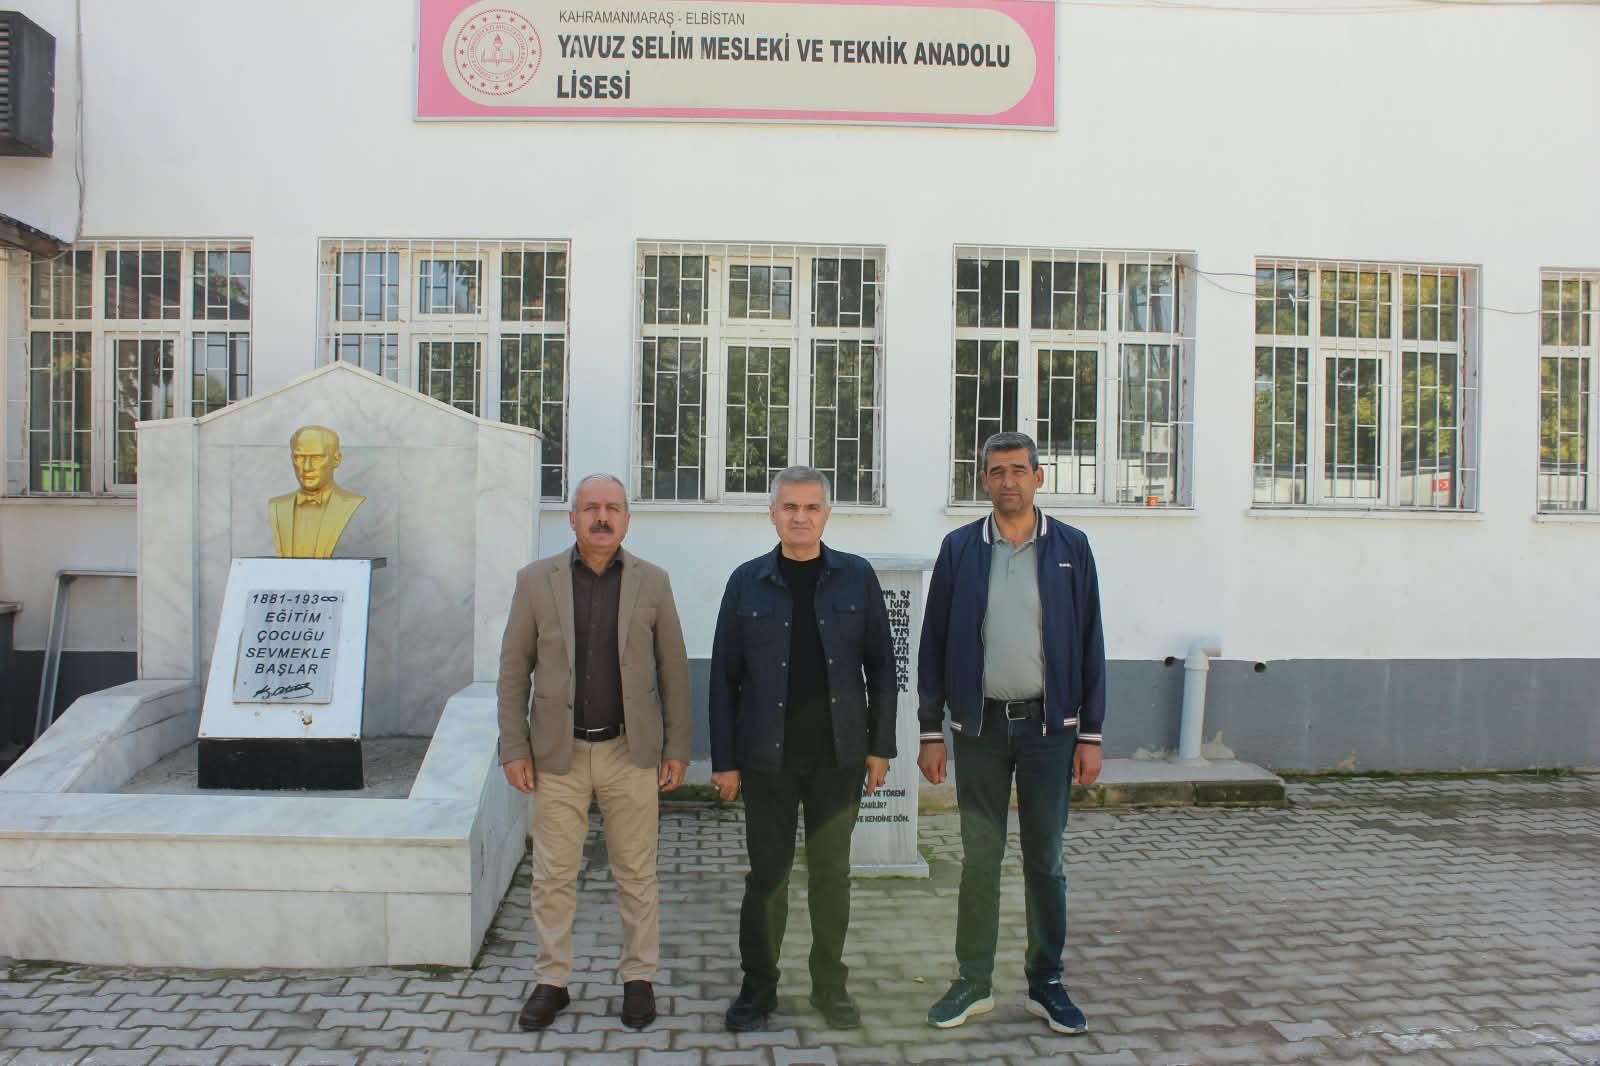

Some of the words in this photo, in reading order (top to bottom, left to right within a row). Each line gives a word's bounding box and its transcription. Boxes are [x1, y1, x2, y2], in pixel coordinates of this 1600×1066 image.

[559, 10, 675, 28] KAHRAMANMARAŞ
[685, 10, 745, 26] ELBİSTAN
[557, 34, 626, 59] YAVUZ
[631, 30, 694, 60] SELİM
[700, 32, 790, 62] MESLEKİ
[797, 39, 824, 63] VE
[829, 35, 908, 65] TEKNİK
[913, 41, 1010, 68] ANADOLU
[556, 69, 631, 100] LİSESİ
[265, 608, 321, 623] EĞİTİM
[257, 627, 325, 643] ÇOCUĞU
[246, 647, 331, 658] SEVMEKLE
[254, 663, 319, 676] BAŞLAR
